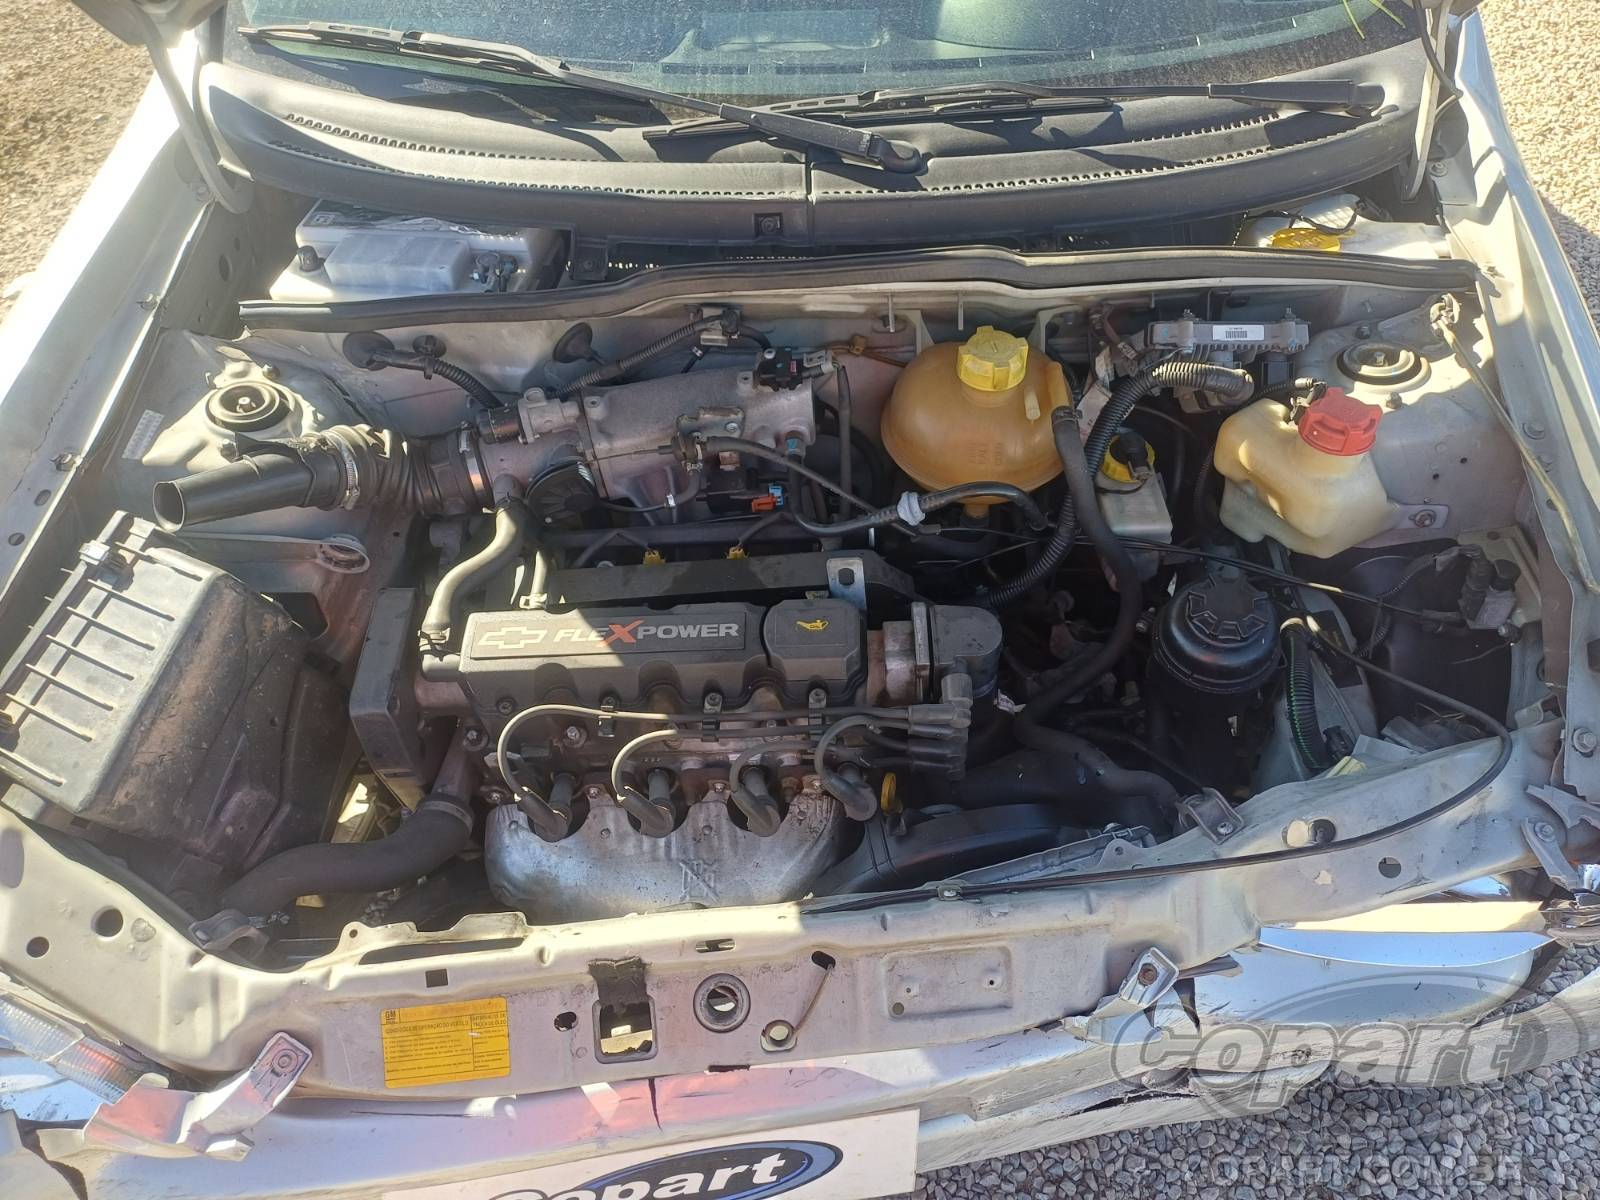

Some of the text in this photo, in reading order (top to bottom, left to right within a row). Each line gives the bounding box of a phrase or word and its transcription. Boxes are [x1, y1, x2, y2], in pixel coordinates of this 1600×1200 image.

[553, 619, 738, 648] FLEXPOWER
[385, 1010, 396, 1019] GM
[489, 1152, 786, 1200] part
